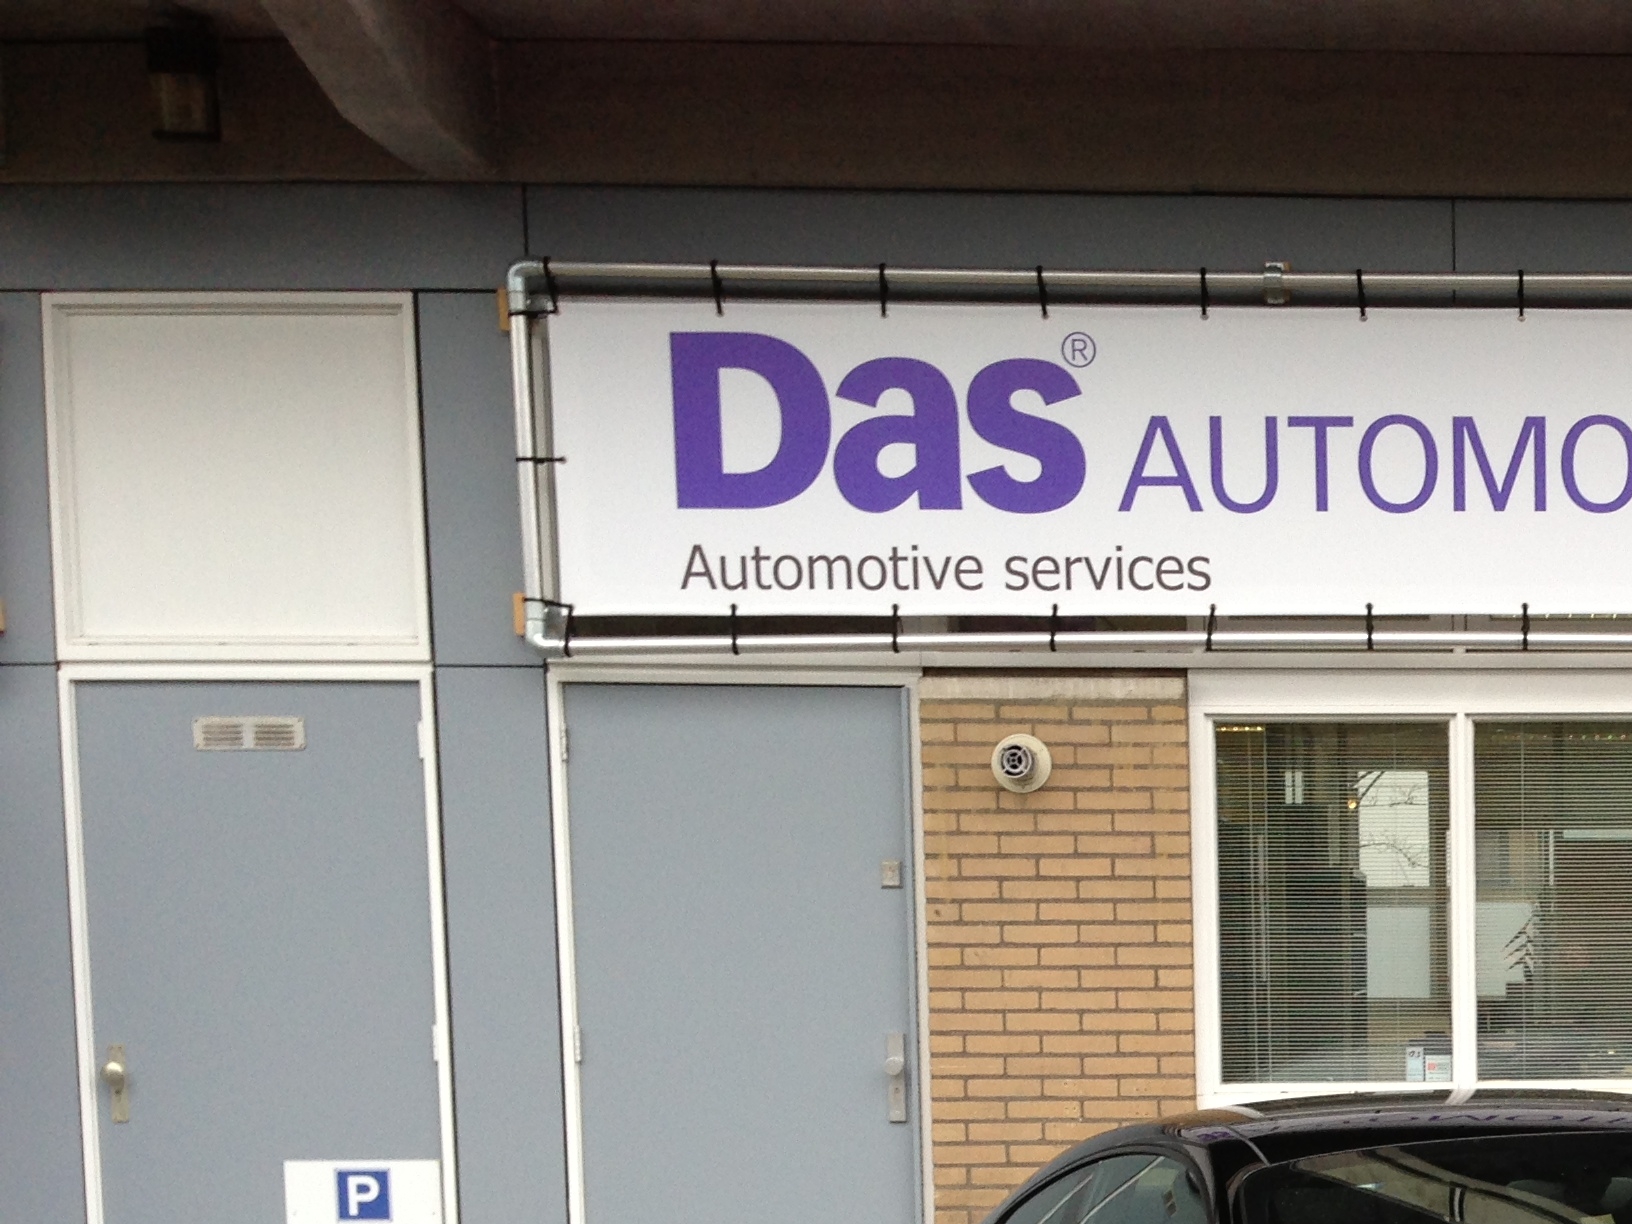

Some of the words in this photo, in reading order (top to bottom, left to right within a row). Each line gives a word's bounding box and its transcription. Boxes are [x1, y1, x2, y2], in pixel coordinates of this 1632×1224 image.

[681, 544, 983, 591] Automotive
[1005, 545, 1211, 592] services
[347, 1175, 380, 1217] P
